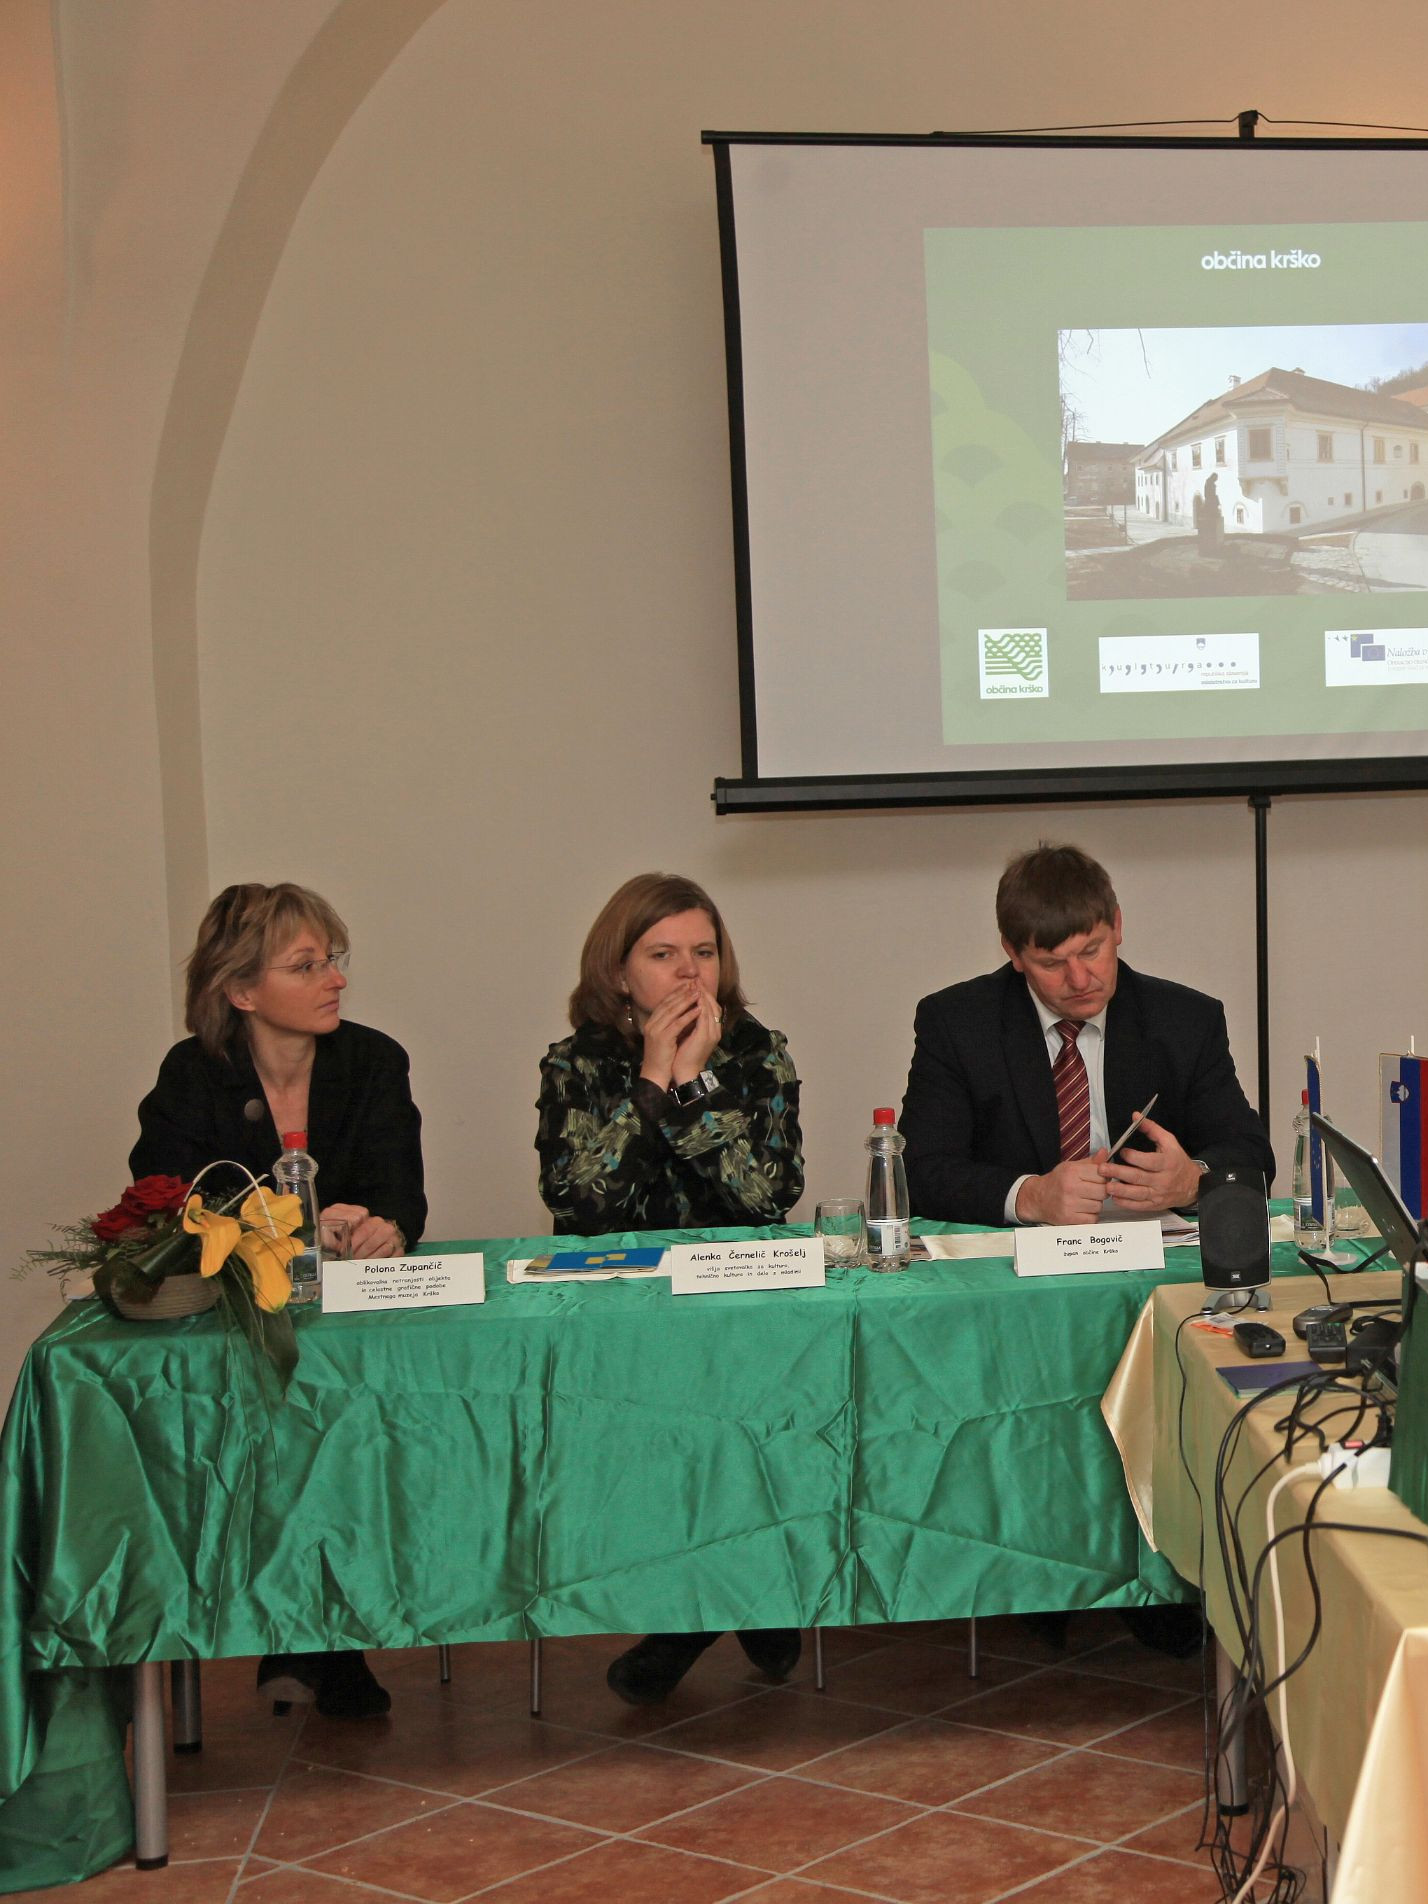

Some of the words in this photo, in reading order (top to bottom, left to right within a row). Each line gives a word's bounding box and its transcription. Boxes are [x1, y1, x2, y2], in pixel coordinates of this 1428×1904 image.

[1201, 250, 1267, 270] občina
[1270, 249, 1322, 268] krško
[986, 685, 1018, 694] občina
[1019, 684, 1043, 694] krško
[1056, 1237, 1082, 1246] Franc
[1090, 1234, 1123, 1246] Bogovič
[690, 1253, 721, 1262] Alenka
[728, 1249, 766, 1260] Černelič
[773, 1248, 806, 1259] Krošelj
[364, 1265, 395, 1274] Polona
[399, 1261, 443, 1273] Zupančič
